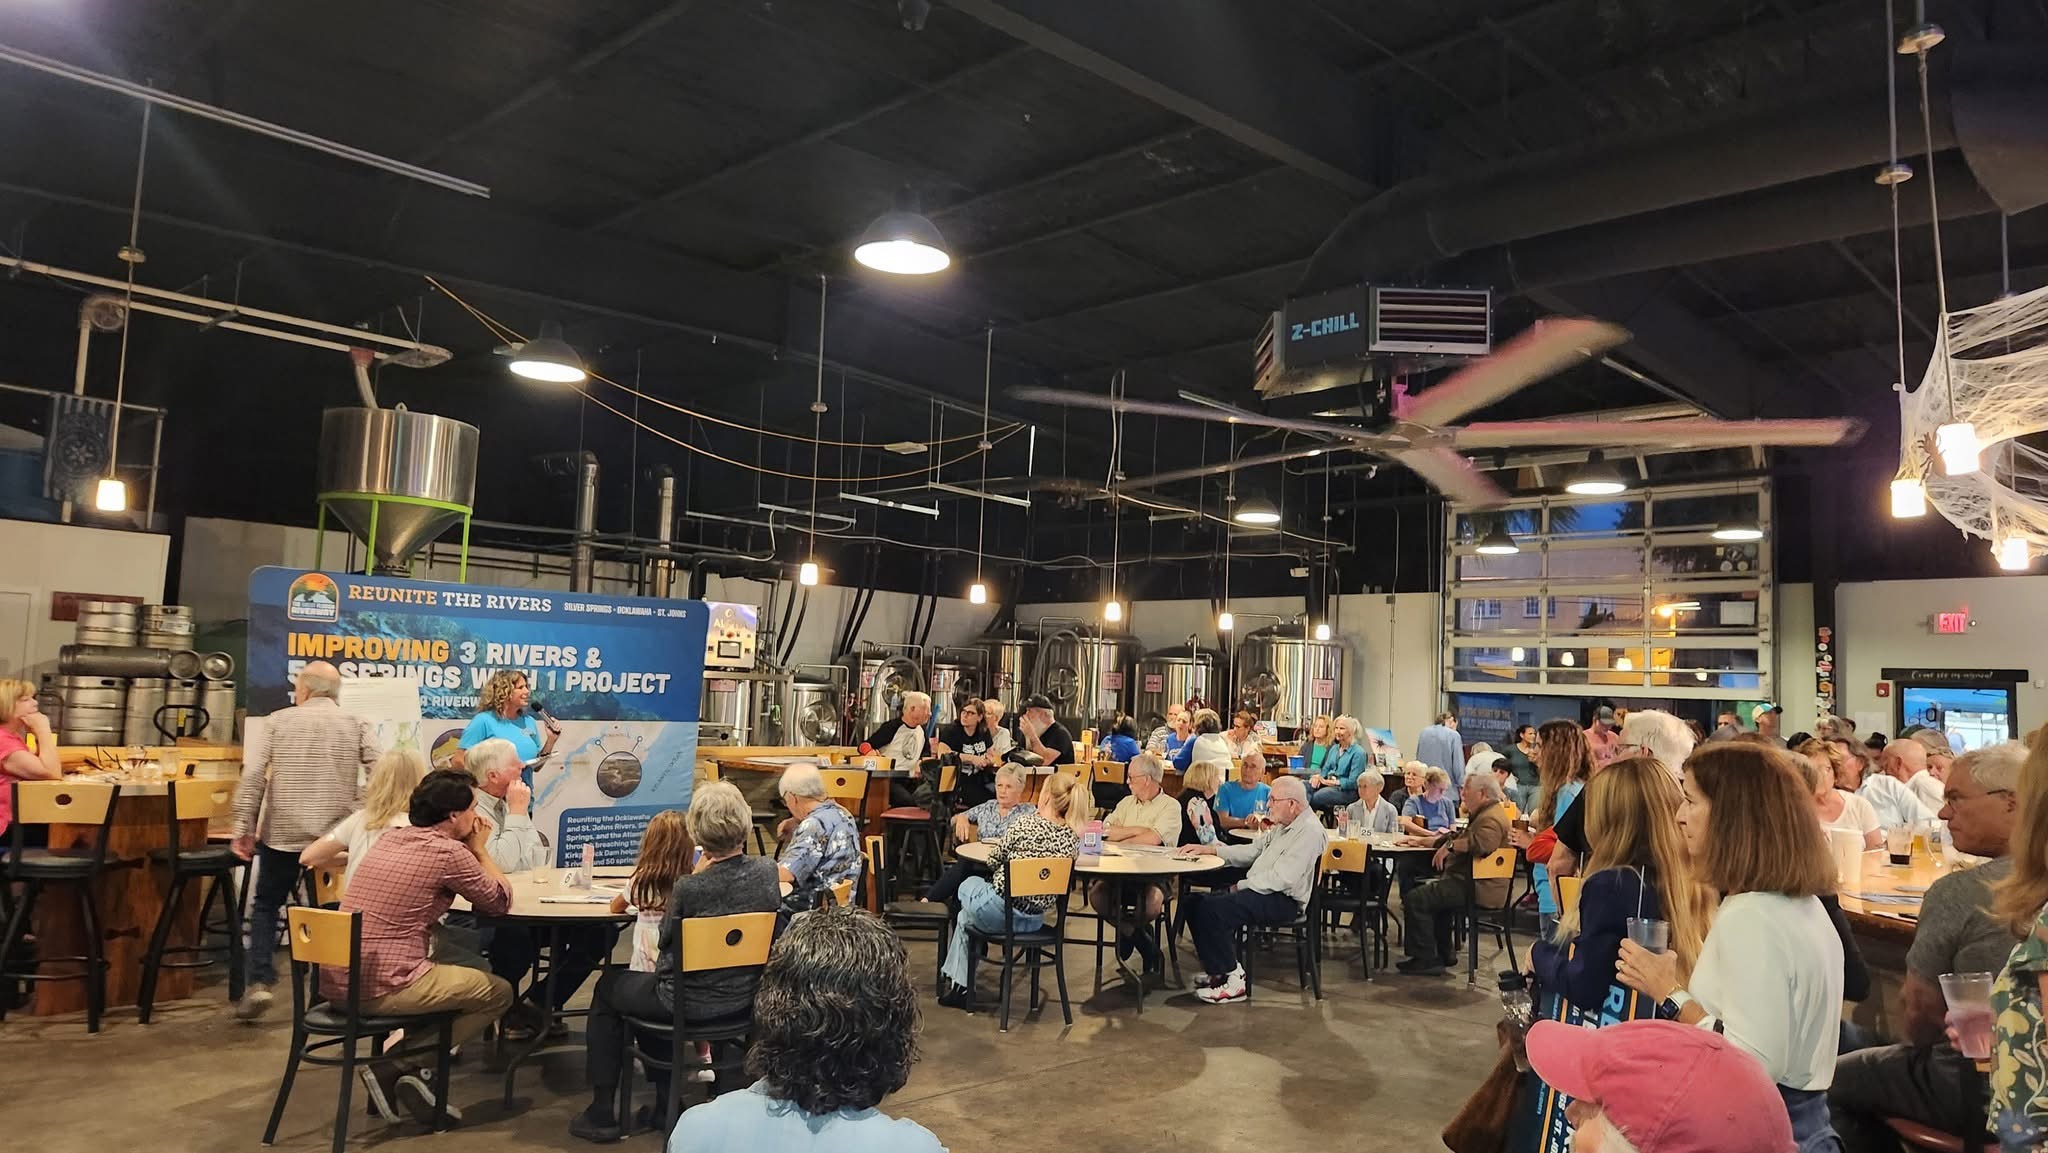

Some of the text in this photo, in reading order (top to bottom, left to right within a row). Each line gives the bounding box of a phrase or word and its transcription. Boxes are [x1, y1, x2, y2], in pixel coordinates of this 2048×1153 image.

[1292, 312, 1359, 341] Z-CHILL
[349, 585, 552, 612] REUNITE THE RIVERS
[564, 603, 585, 612] SILVER
[586, 605, 612, 614] SPRINGS
[667, 609, 686, 618] JOHNS
[1939, 612, 1966, 633] EXIT
[288, 632, 602, 668] IMPROVING 3 RIVERS &
[548, 671, 557, 691] 1
[565, 671, 671, 694] PROJECT
[567, 816, 601, 824] Reuniting
[596, 840, 629, 849] breaching
